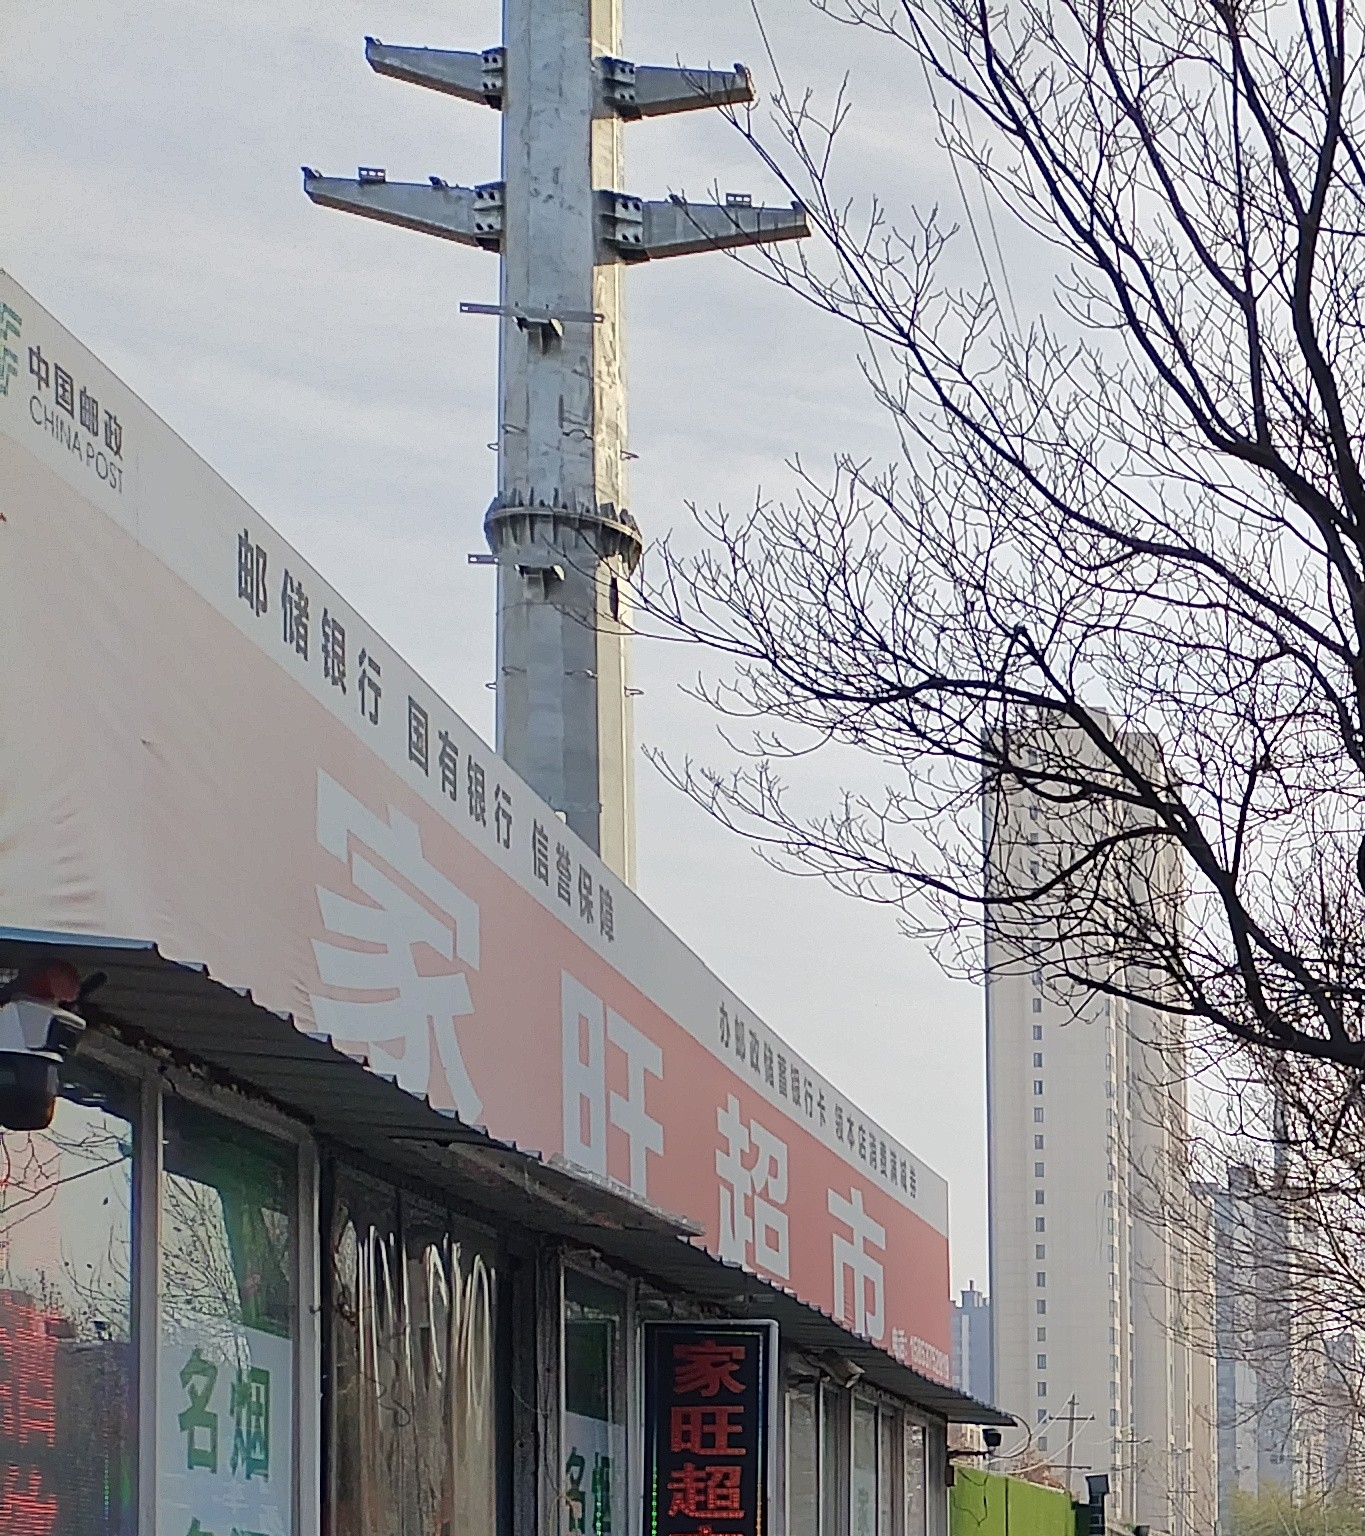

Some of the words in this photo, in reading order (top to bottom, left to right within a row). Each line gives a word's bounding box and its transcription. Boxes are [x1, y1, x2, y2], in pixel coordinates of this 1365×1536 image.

[28, 345, 123, 461] 中国邮政
[30, 395, 83, 463] CHINA
[86, 441, 123, 494] POST
[238, 528, 382, 726] 邮储银行
[408, 695, 512, 860] 国有银行
[532, 818, 614, 942] 信誉保障
[309, 766, 887, 1341] 家旺超市
[179, 1347, 271, 1482] 名烟
